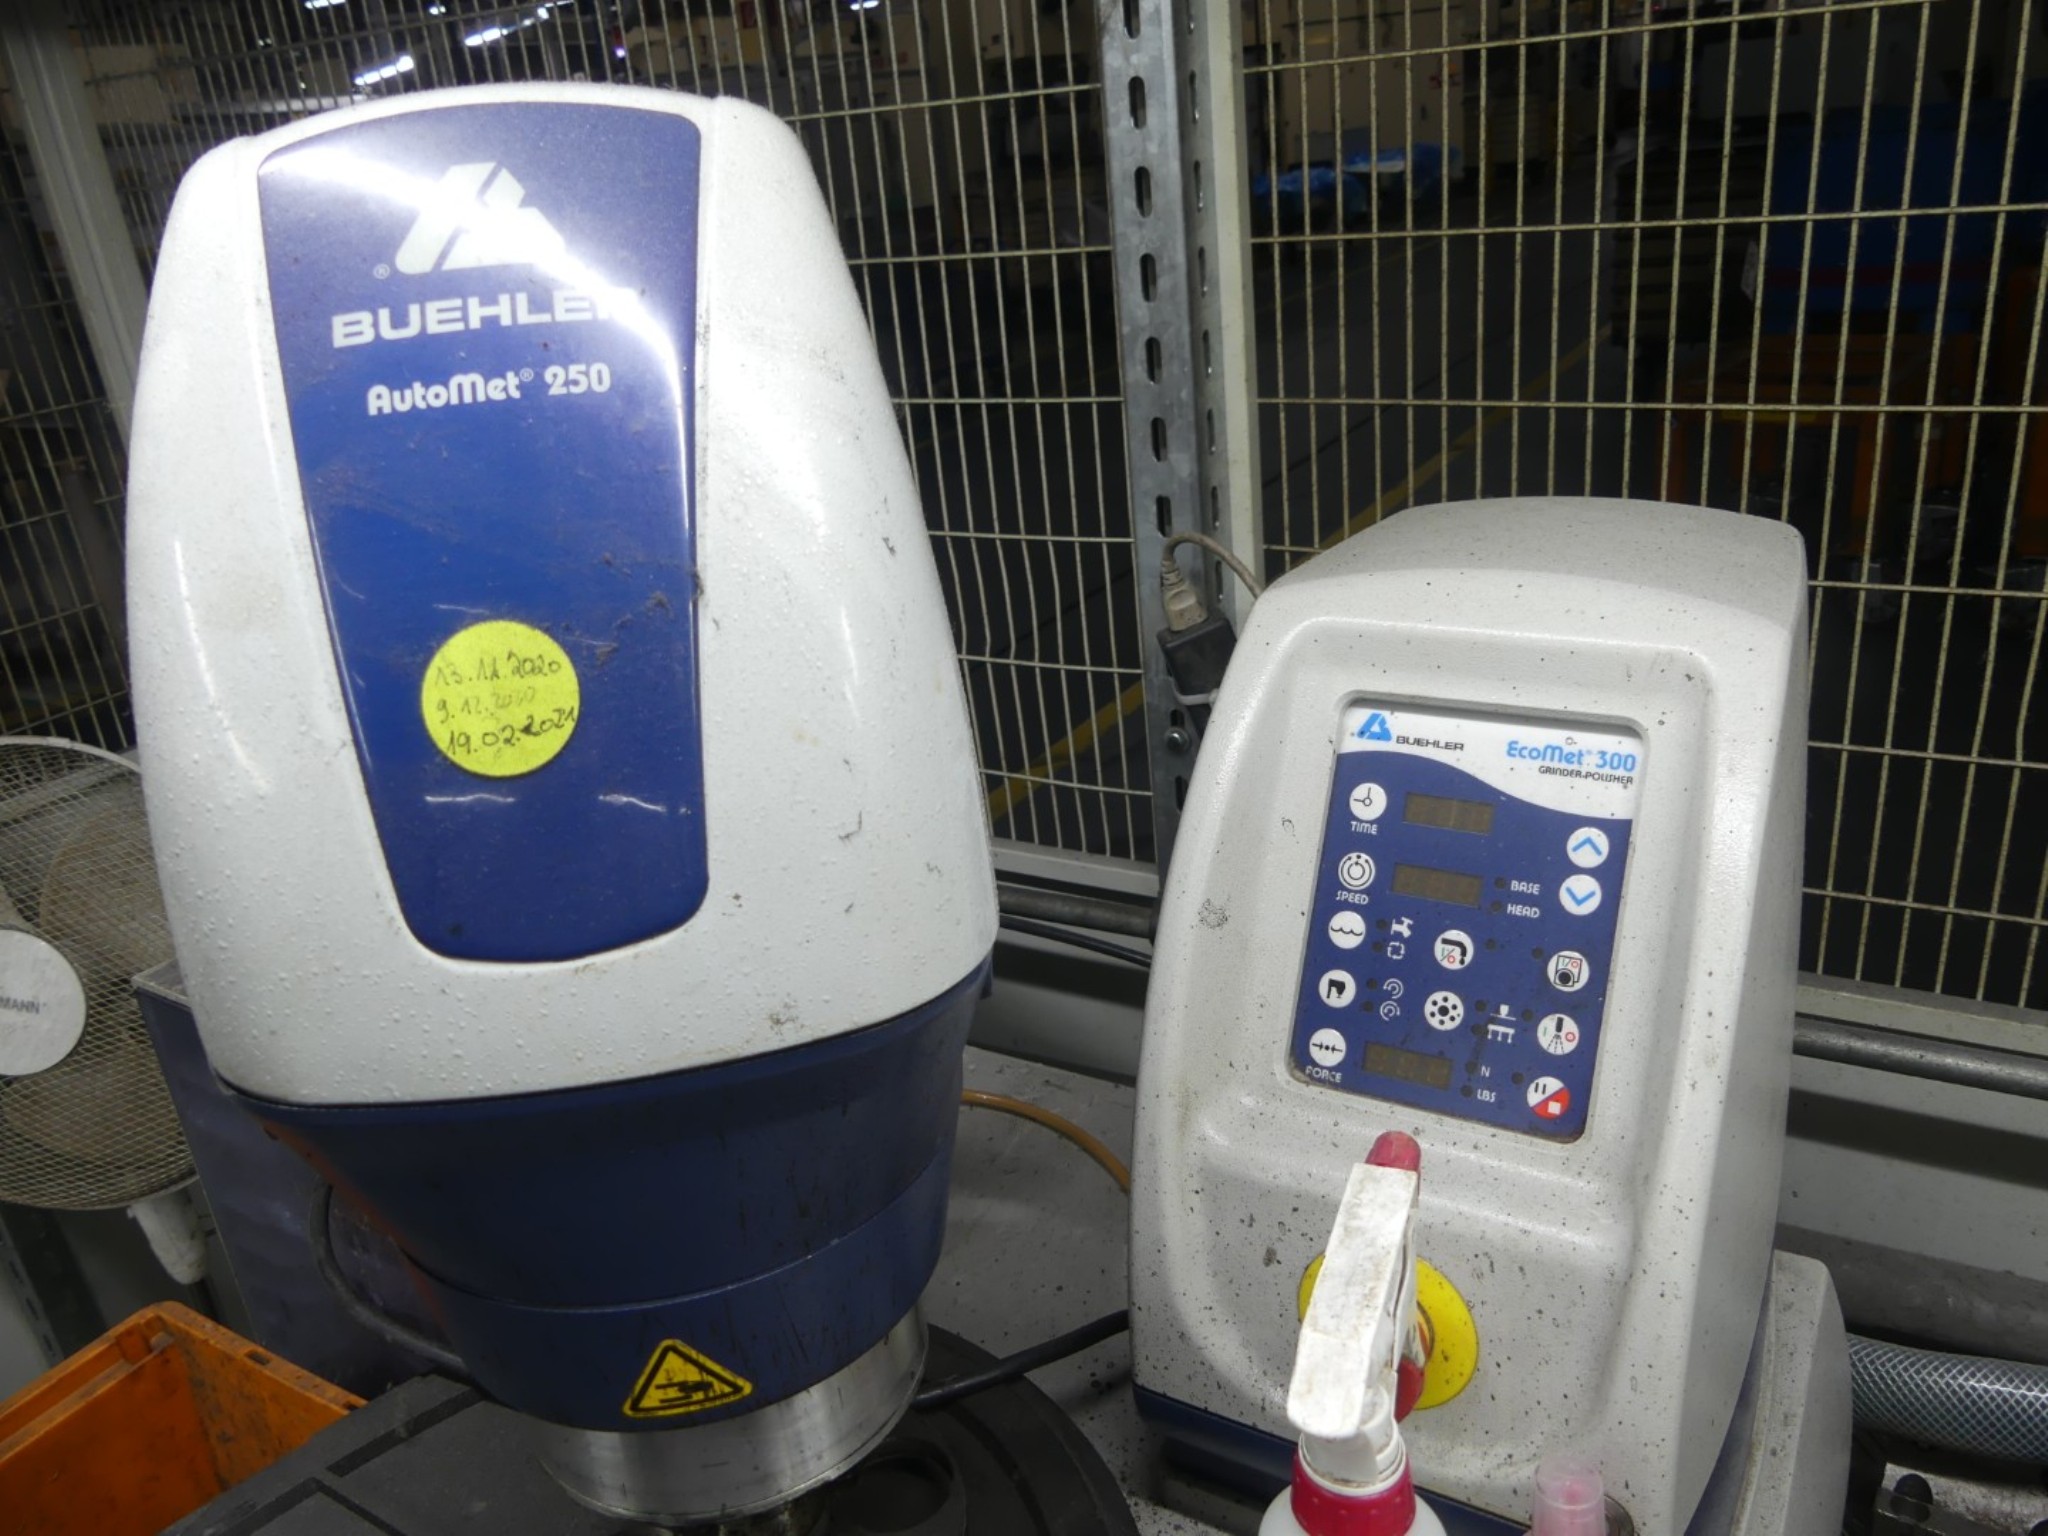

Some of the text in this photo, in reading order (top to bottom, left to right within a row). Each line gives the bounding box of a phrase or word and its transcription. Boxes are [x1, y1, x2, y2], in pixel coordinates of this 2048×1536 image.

[331, 288, 640, 348] BUEHLE
[544, 362, 611, 396] 250
[1396, 735, 1464, 752] BUEHLER
[1595, 750, 1636, 773] 300
[1350, 821, 1378, 836] TIME
[1510, 880, 1541, 896] BASE
[1335, 890, 1369, 906] SPEED
[1507, 903, 1540, 919] HEAD
[1305, 1067, 1342, 1084] FORCE
[1480, 1065, 1491, 1078] N
[1477, 1088, 1497, 1103] LBS
